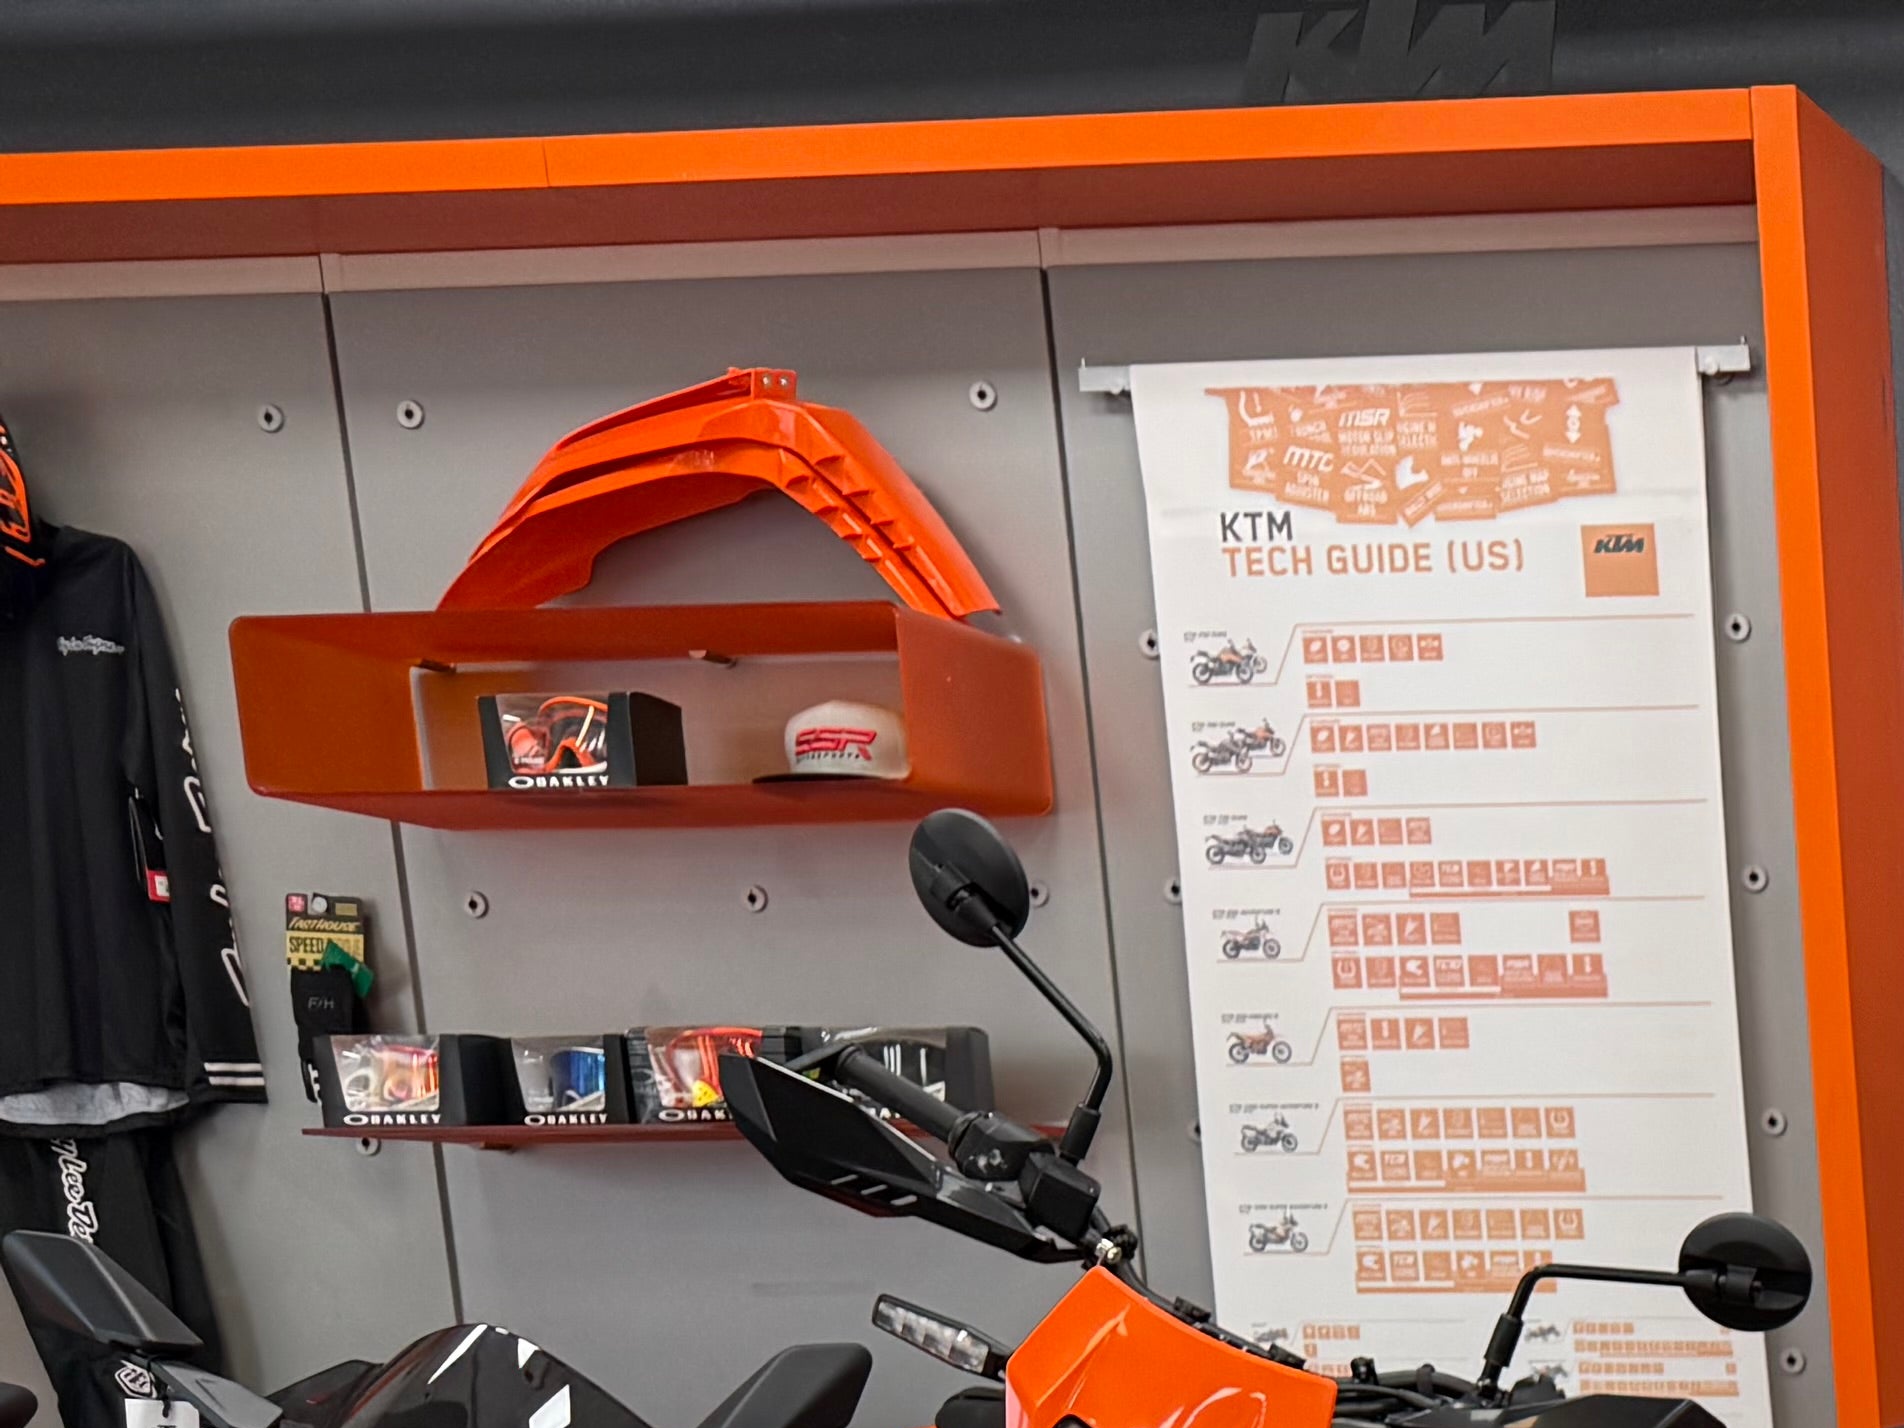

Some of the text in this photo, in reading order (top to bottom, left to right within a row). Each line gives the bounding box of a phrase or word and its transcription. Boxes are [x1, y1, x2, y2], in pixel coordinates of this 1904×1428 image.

[1220, 512, 1293, 543] KTM
[1594, 533, 1646, 555] KTM
[1222, 540, 1525, 577] TECH GUIDE (US)
[508, 775, 609, 789] OAKLEY
[289, 937, 325, 954] SPEED
[343, 1112, 442, 1126] OAKLEY
[524, 1112, 608, 1126] OAKLEY
